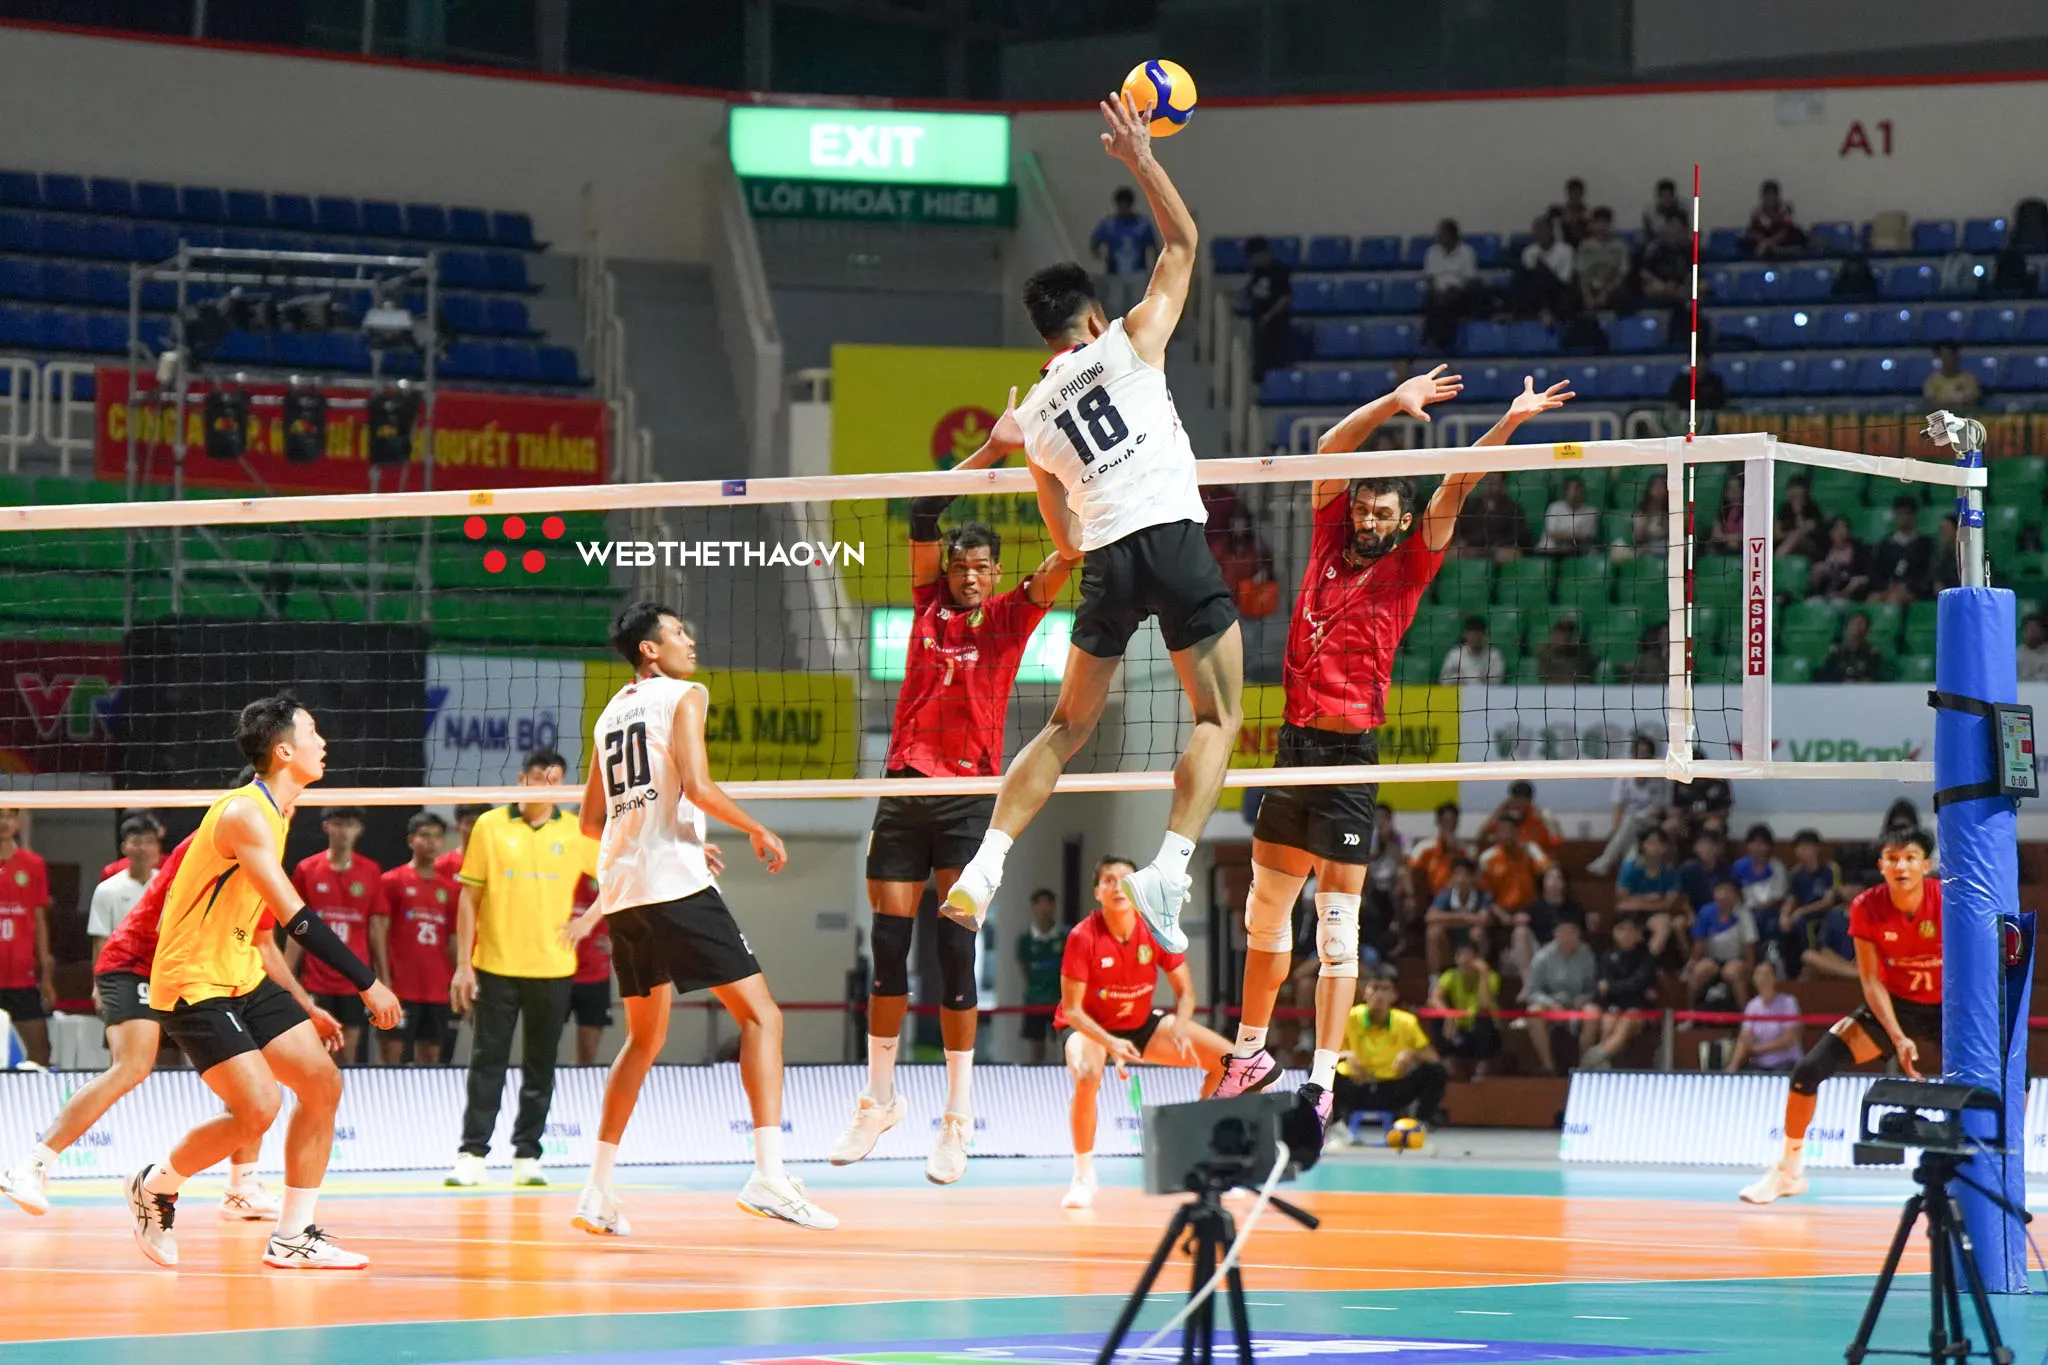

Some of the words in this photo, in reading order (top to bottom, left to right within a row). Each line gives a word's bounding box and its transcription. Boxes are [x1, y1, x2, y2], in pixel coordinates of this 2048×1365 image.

[810, 123, 926, 168] EXIT
[1838, 119, 1893, 159] A1
[1054, 385, 1129, 466] 18
[444, 715, 508, 750] NAM
[752, 706, 822, 745] MAU
[605, 721, 651, 797] 20
[2010, 775, 2028, 787] 0:00
[1908, 970, 1933, 992] 71
